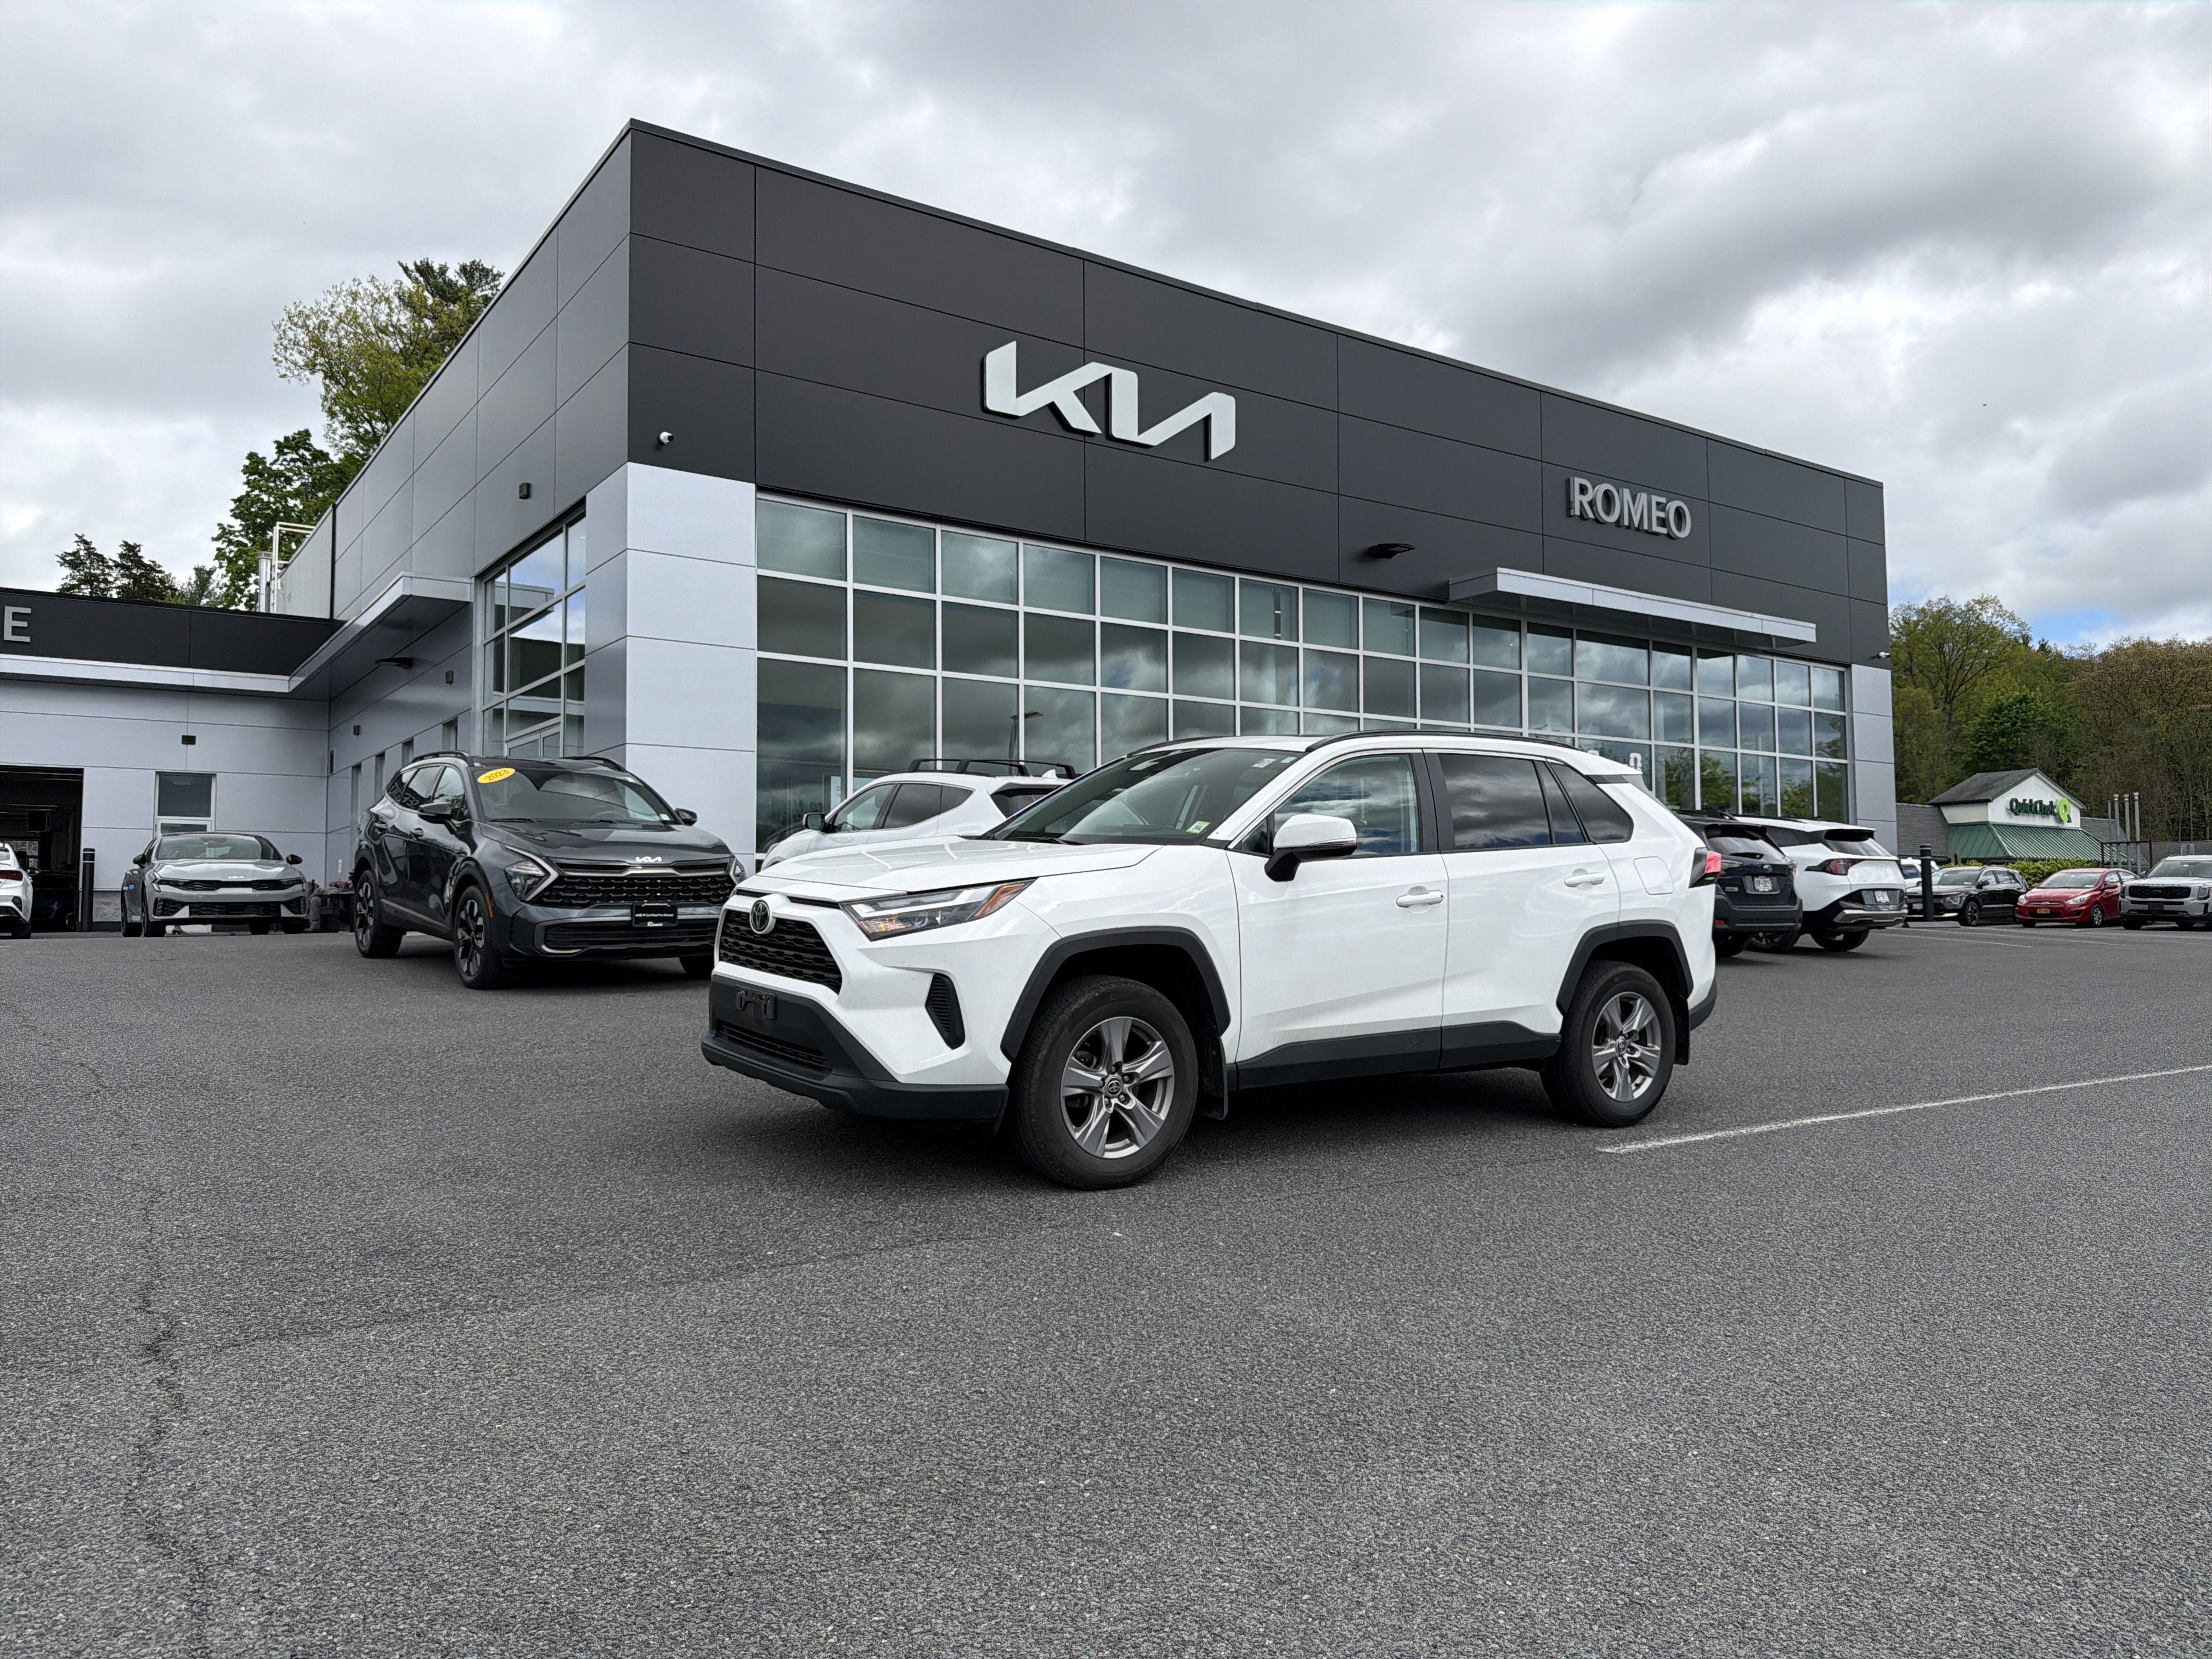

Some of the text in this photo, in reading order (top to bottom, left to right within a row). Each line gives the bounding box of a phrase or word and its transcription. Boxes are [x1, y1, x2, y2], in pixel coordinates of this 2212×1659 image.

[984, 341, 1235, 460] KIA
[1569, 476, 1692, 538] ROMEO
[3, 606, 32, 642] E
[484, 769, 509, 781] 2023
